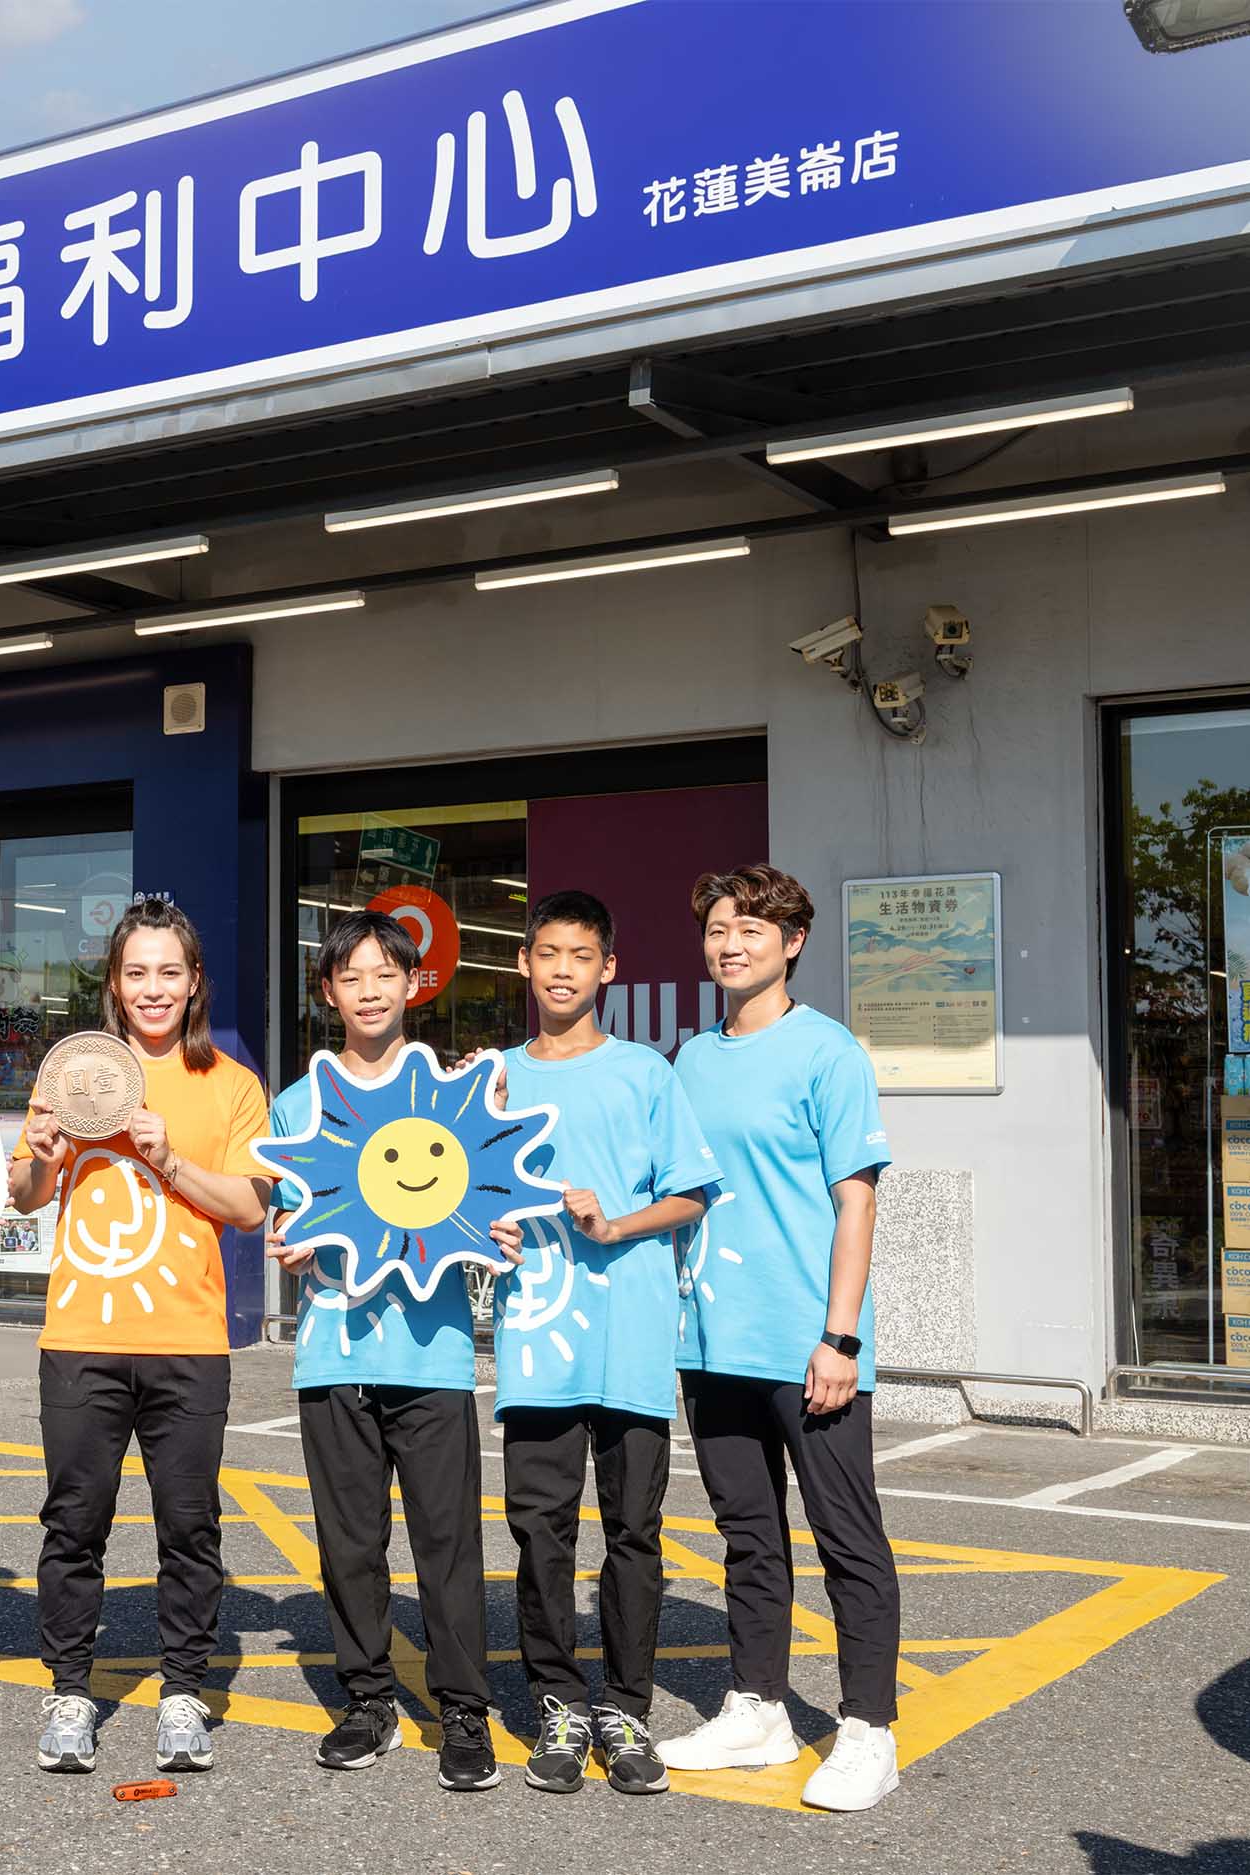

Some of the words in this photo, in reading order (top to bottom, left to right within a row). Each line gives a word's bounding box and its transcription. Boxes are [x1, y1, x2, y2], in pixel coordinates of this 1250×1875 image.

[643, 130, 900, 227] 花蓮美崙店
[593, 981, 727, 1056] MUJ
